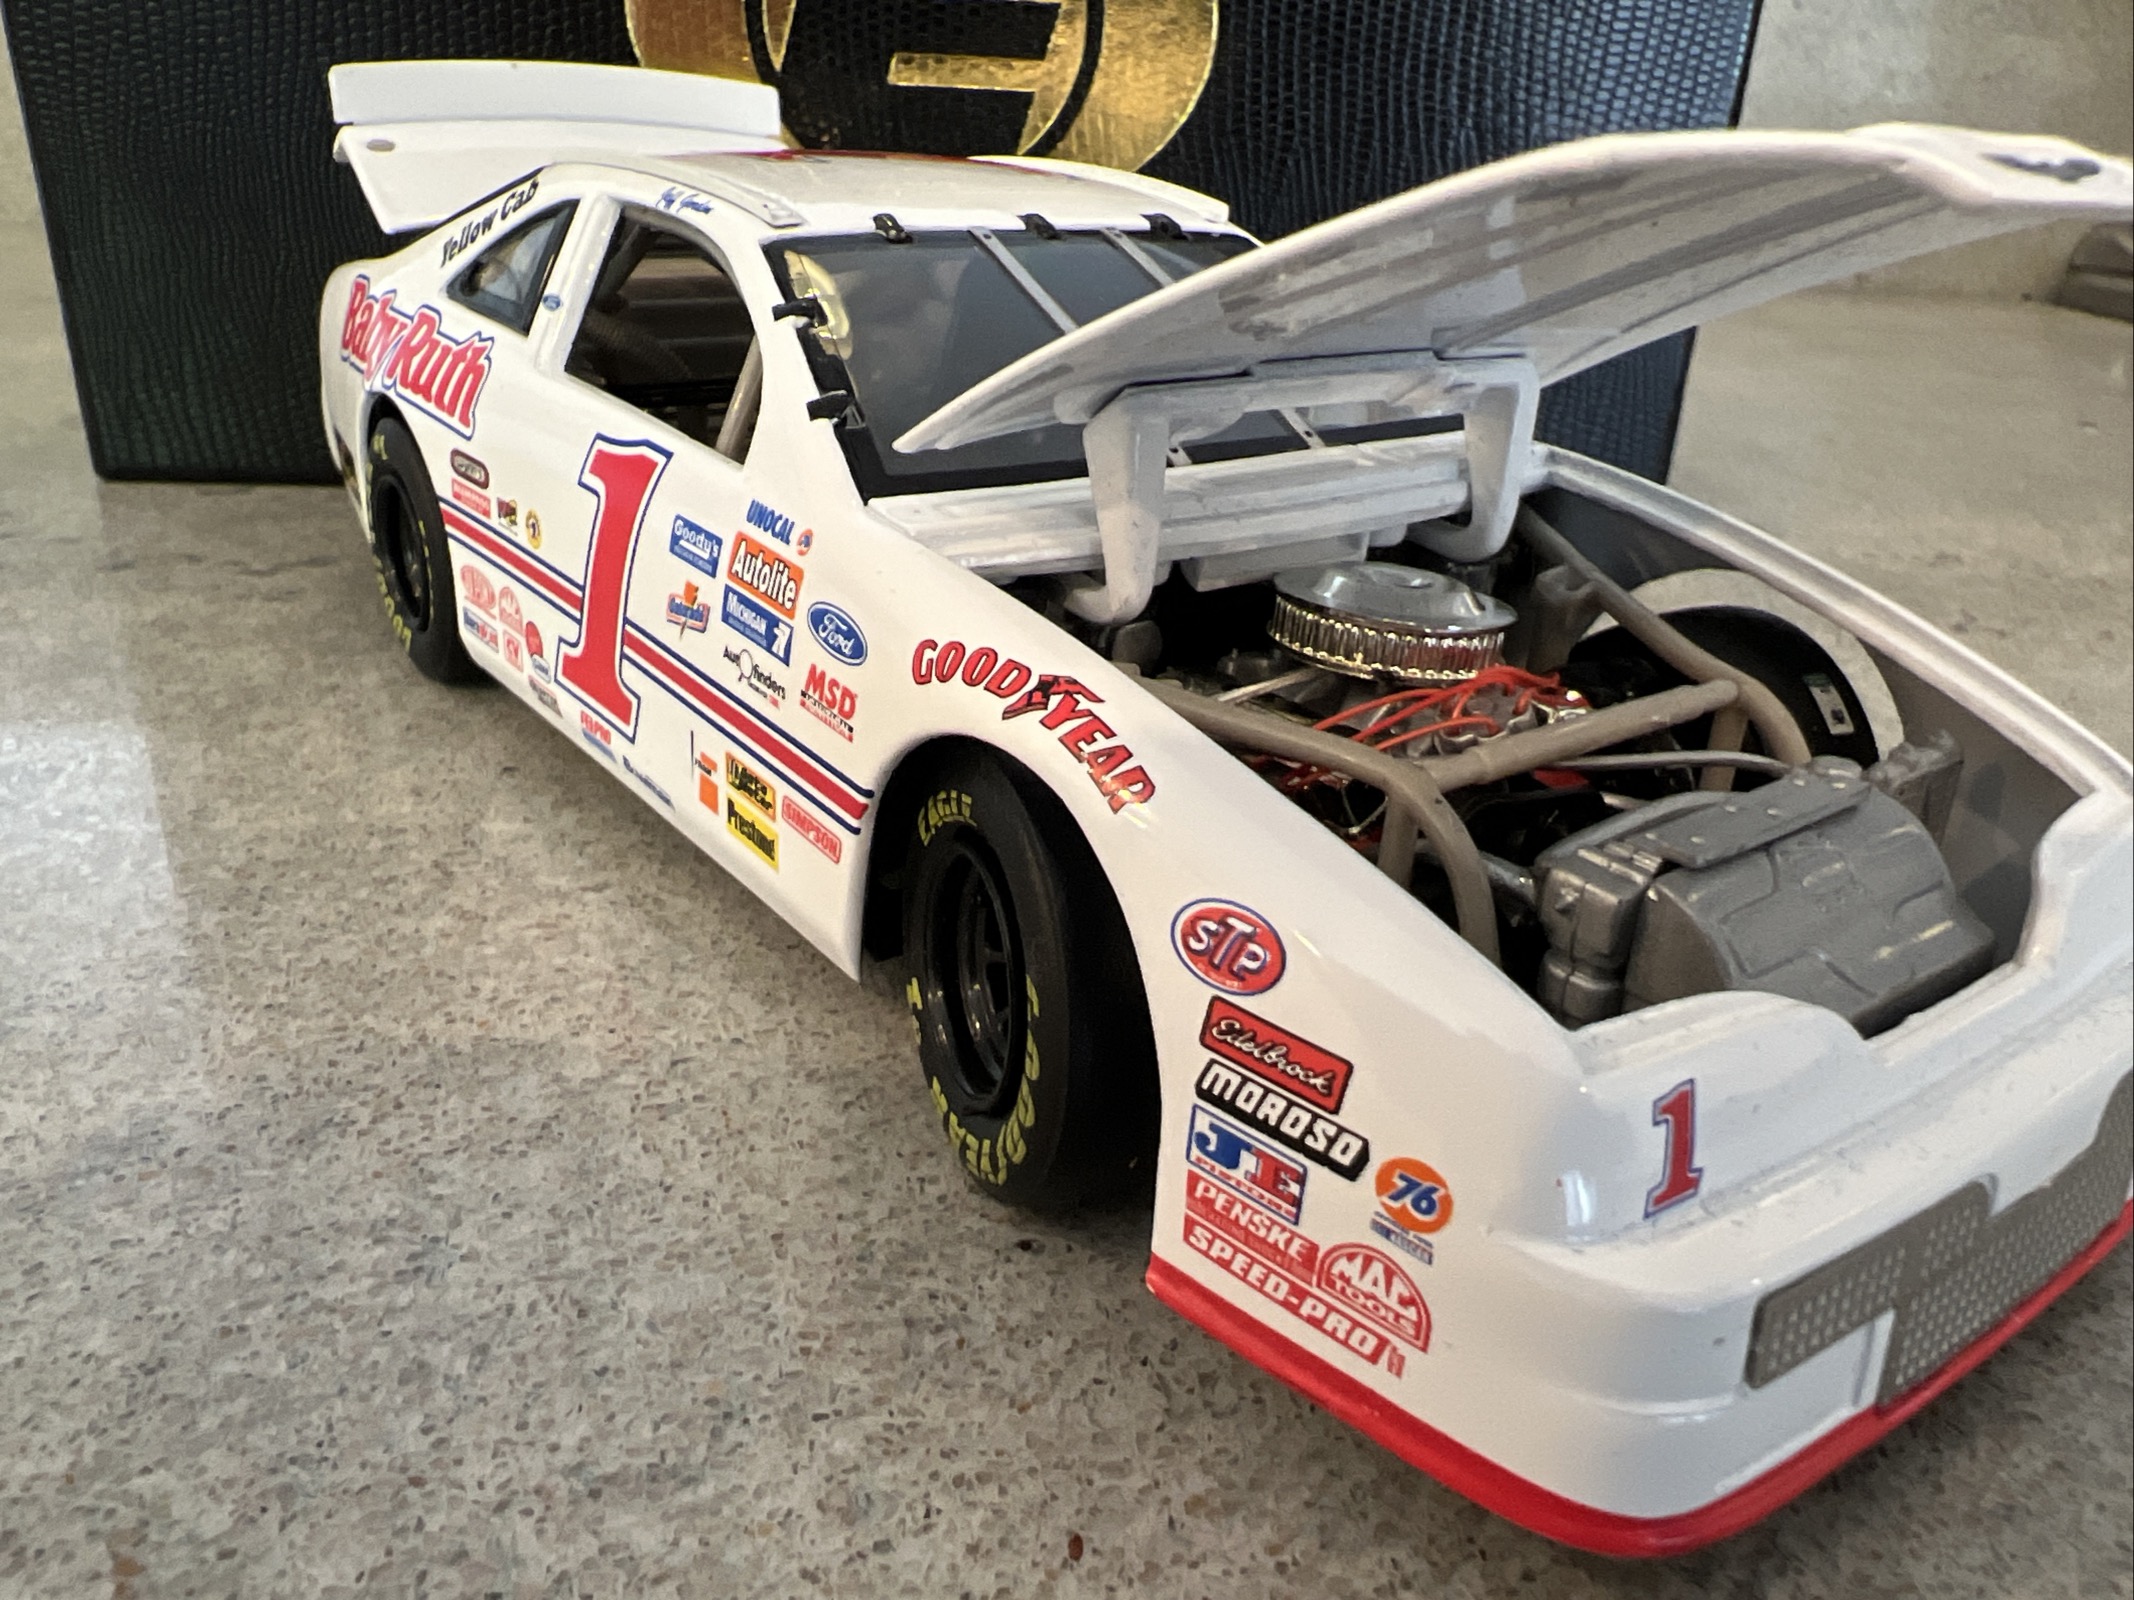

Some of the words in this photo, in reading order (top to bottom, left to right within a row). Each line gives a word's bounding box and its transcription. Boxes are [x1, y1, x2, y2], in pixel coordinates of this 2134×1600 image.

[440, 209, 498, 267] Yellow
[500, 177, 540, 222] Cab
[341, 277, 408, 382] Baby
[385, 310, 490, 430] Ruth
[674, 519, 718, 558] Goody's
[747, 499, 795, 545] UNOCAL
[554, 432, 674, 744] 1
[731, 539, 797, 610] Autolite
[818, 613, 854, 656] Ford
[805, 663, 856, 720] MSD
[784, 803, 838, 854] SIMPSON
[1187, 915, 1270, 979] STP
[1212, 1018, 1335, 1096] Edelbrock
[1201, 1062, 1361, 1167] MOROSO
[1642, 1077, 1703, 1221] 1
[1194, 1179, 1310, 1262] PENSKE
[1388, 1172, 1440, 1215] 76
[1189, 1225, 1379, 1357] SPEED-PRO
[1331, 1254, 1418, 1322] MAC
